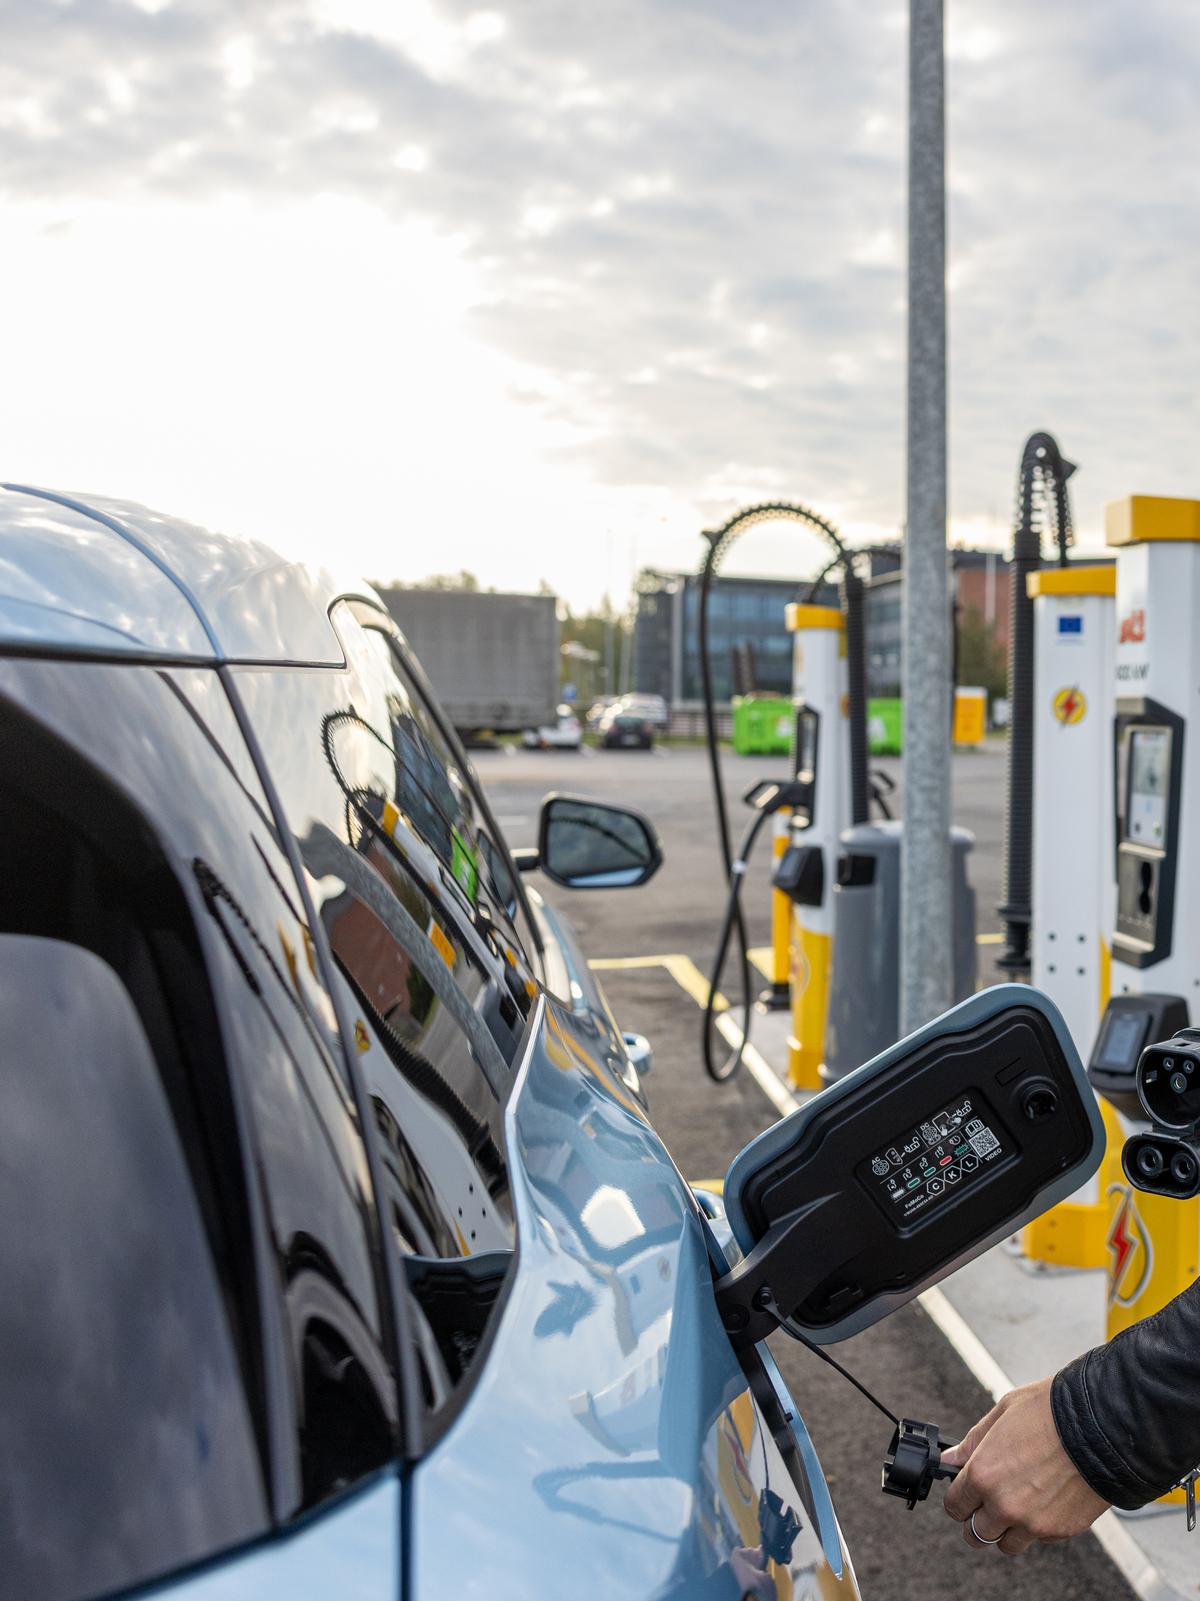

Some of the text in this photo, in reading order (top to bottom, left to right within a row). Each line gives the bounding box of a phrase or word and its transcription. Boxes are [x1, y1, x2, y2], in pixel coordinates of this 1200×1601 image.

[920, 1122, 930, 1131] DC
[872, 1156, 881, 1165] AC
[984, 1147, 1002, 1161] VIDEO
[932, 1160, 974, 1191] C K L
[904, 1194, 925, 1209] FoMoCo
